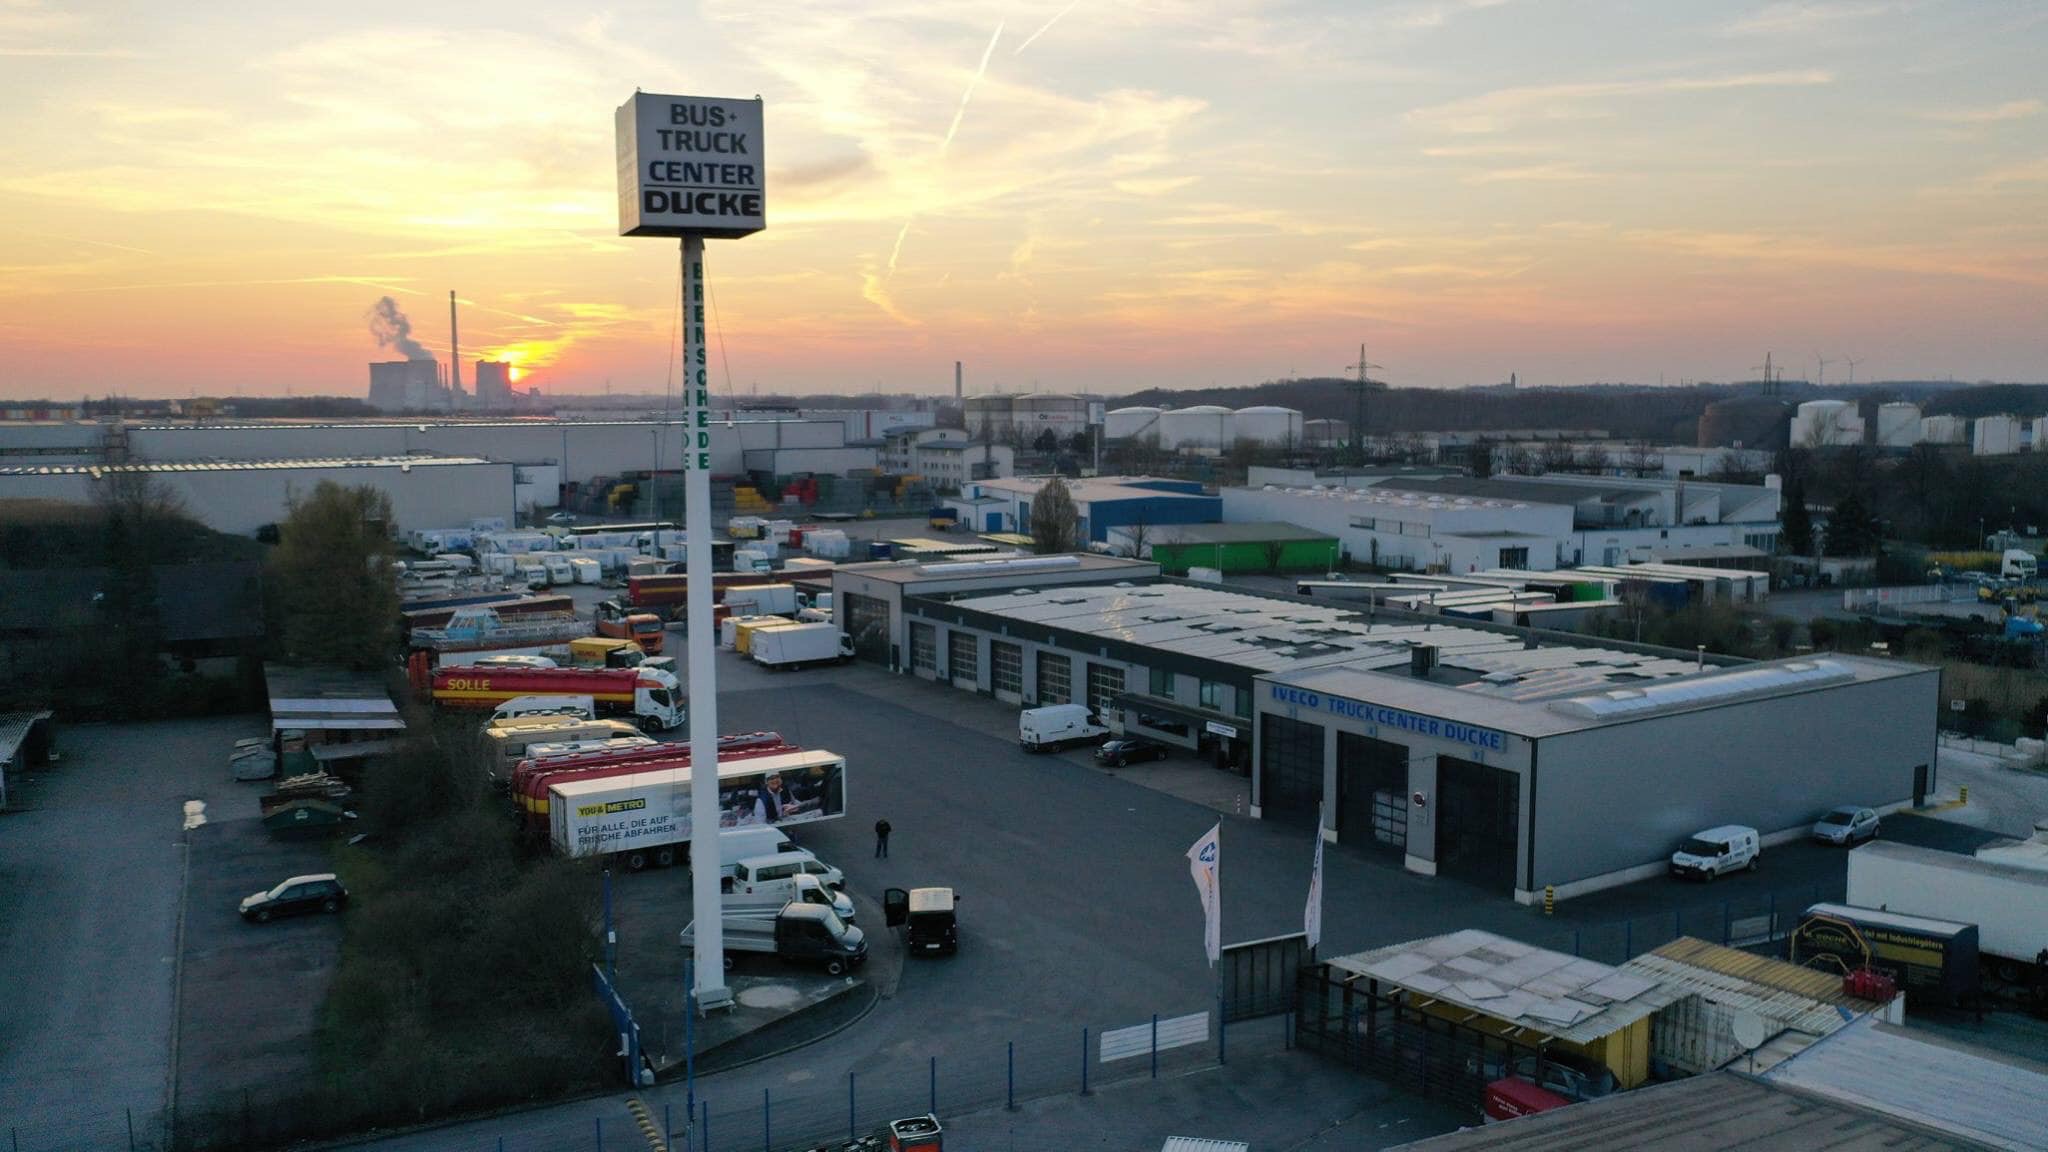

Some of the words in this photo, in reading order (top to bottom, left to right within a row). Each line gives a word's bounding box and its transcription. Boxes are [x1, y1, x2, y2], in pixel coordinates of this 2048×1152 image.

[656, 129, 748, 154] TRUCK
[649, 161, 755, 185] CENTER
[644, 190, 761, 216] DUCKE
[447, 679, 490, 690] SOLLE
[1272, 686, 1319, 707] IVECO
[1328, 698, 1374, 721] TRUCK
[1378, 709, 1439, 735] CENTER
[1445, 723, 1500, 749] DUCKE
[607, 800, 643, 812] METRO
[631, 819, 647, 828] DIE
[650, 816, 669, 825] AUF
